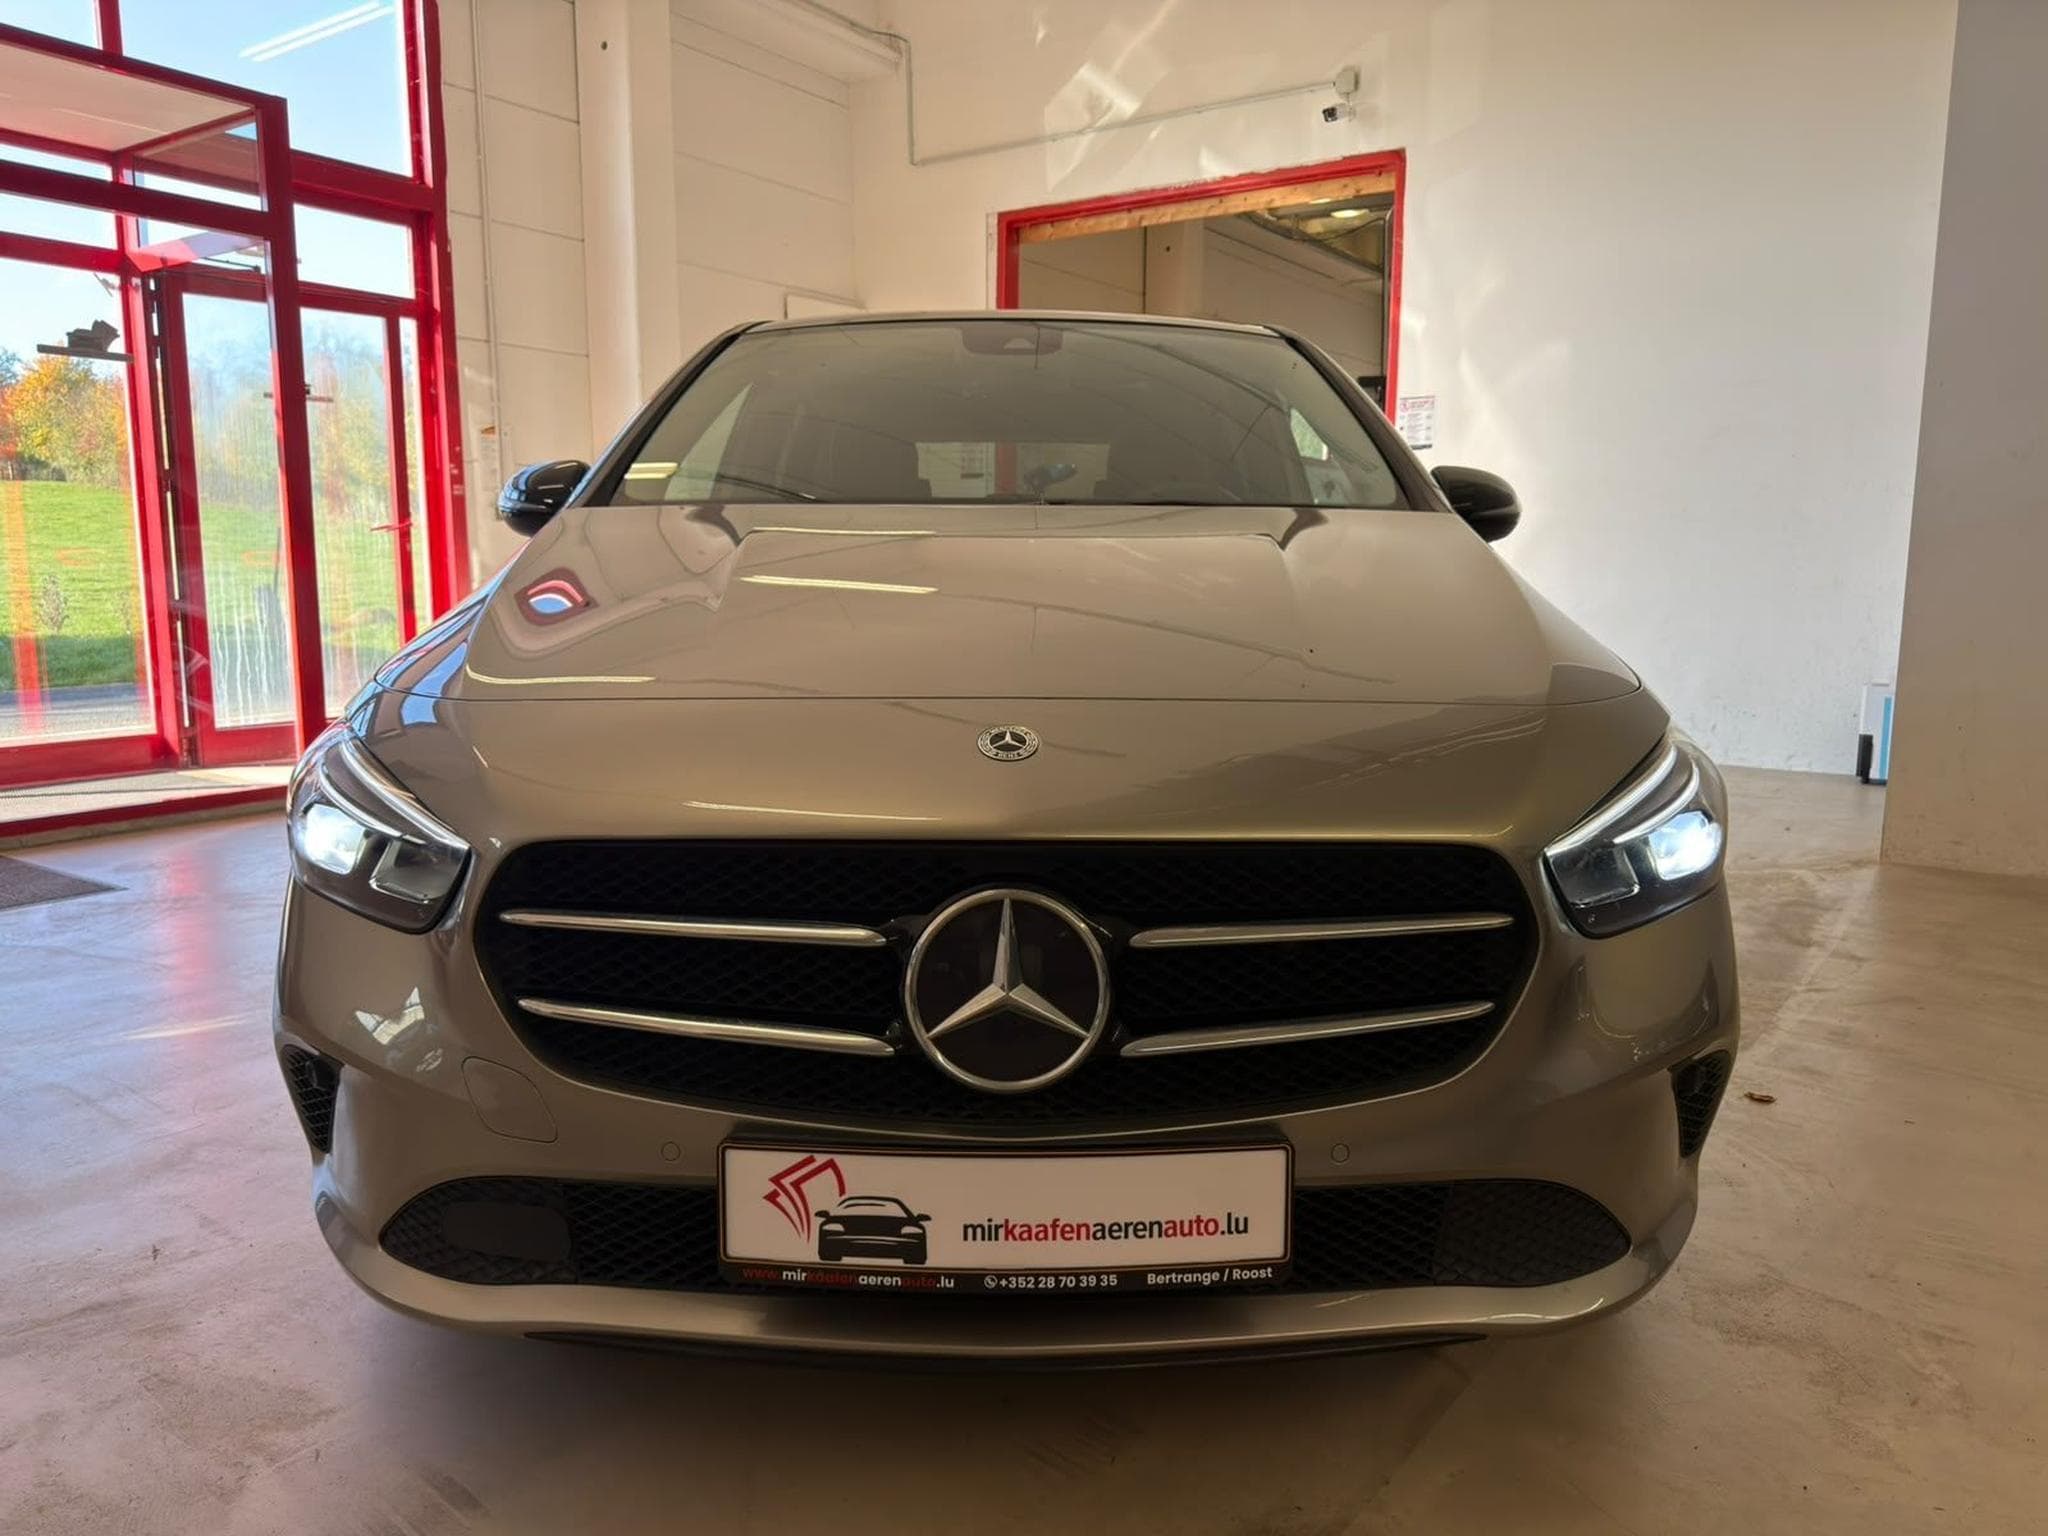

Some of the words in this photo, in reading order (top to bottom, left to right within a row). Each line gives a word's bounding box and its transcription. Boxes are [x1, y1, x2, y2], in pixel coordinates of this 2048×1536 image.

[962, 1212, 1249, 1242] mirkaafenaerenauto.lu
[1000, 1276, 1035, 1289] +352
[1037, 1276, 1056, 1289] 28
[1059, 1276, 1076, 1288] 70
[1079, 1275, 1097, 1288] 39
[1099, 1274, 1118, 1287] 35
[1147, 1271, 1221, 1285] Bertrange
[1232, 1267, 1273, 1280] Roost
